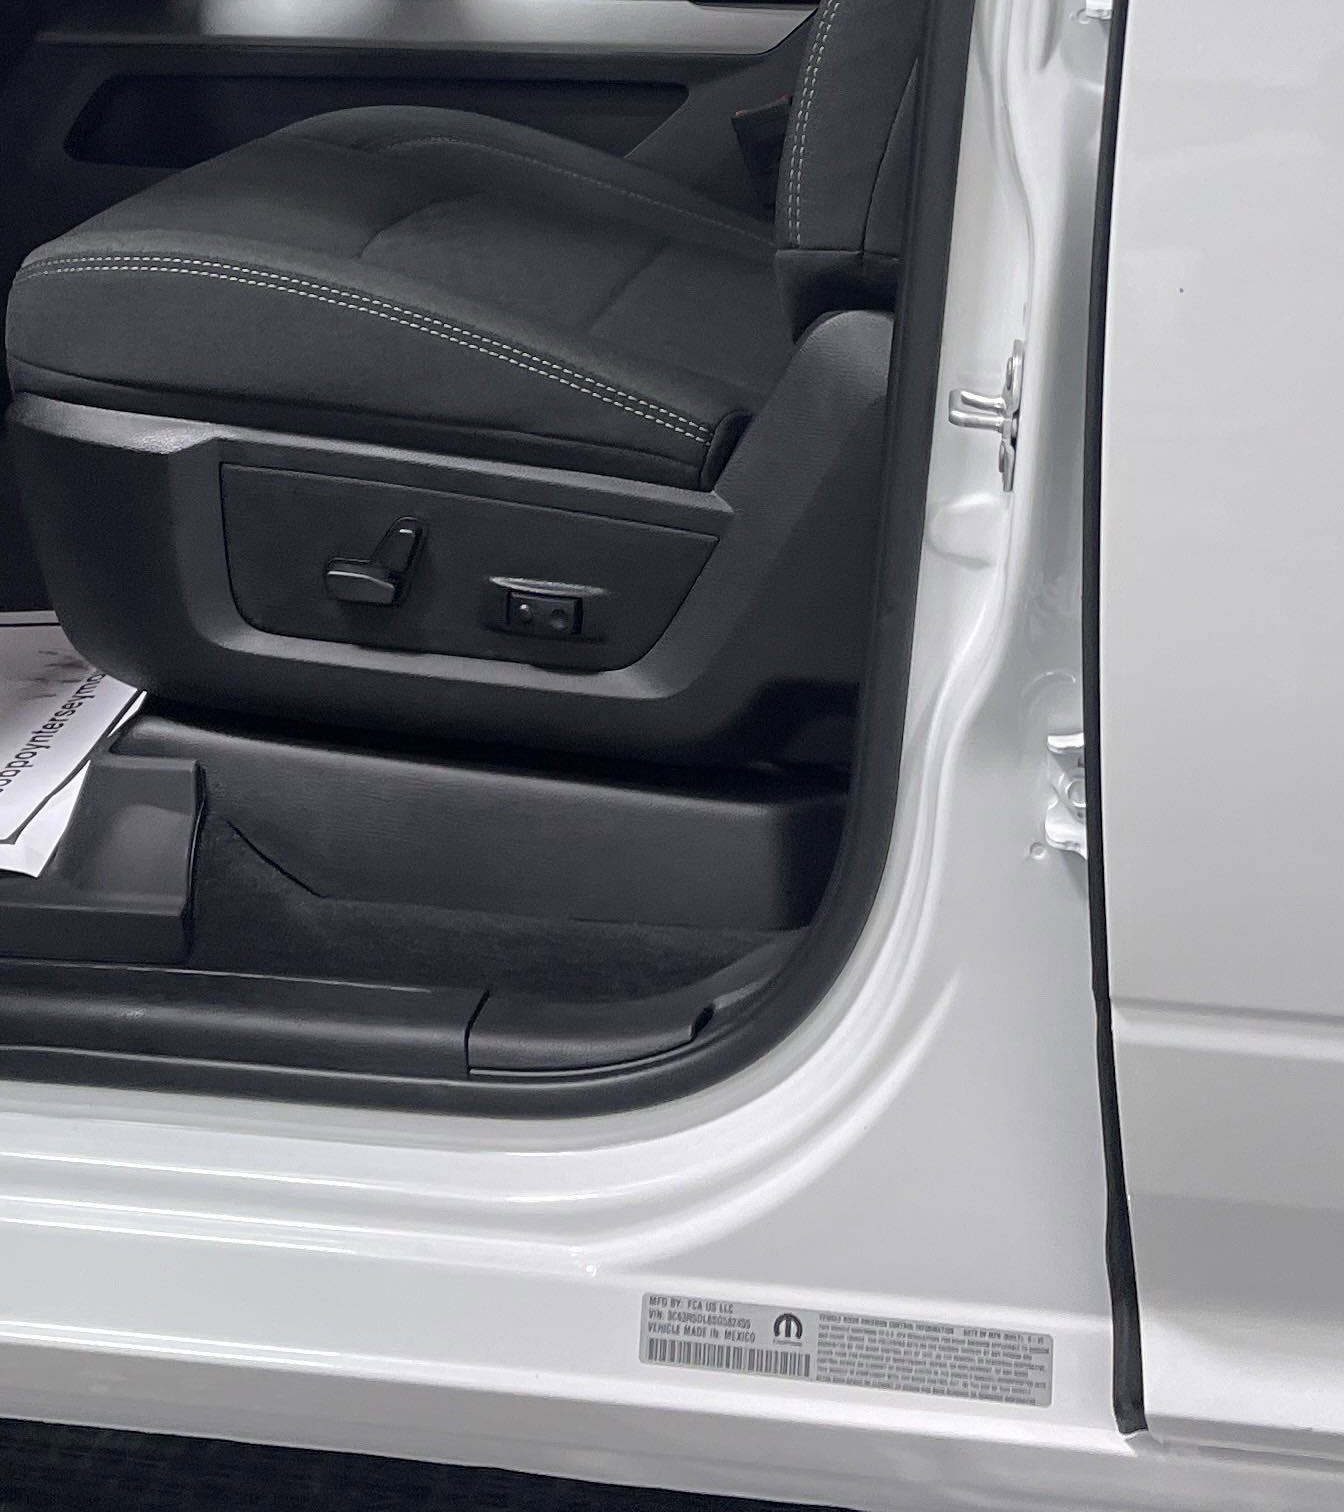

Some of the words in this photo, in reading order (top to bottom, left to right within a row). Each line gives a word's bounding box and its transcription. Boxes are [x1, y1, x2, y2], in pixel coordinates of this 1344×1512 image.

[719, 1303, 734, 1315] LLC
[647, 1321, 681, 1335] VEHICLE
[684, 1324, 707, 1338] MADE
[710, 1327, 720, 1339] IN
[724, 1329, 756, 1344] MEXICO
